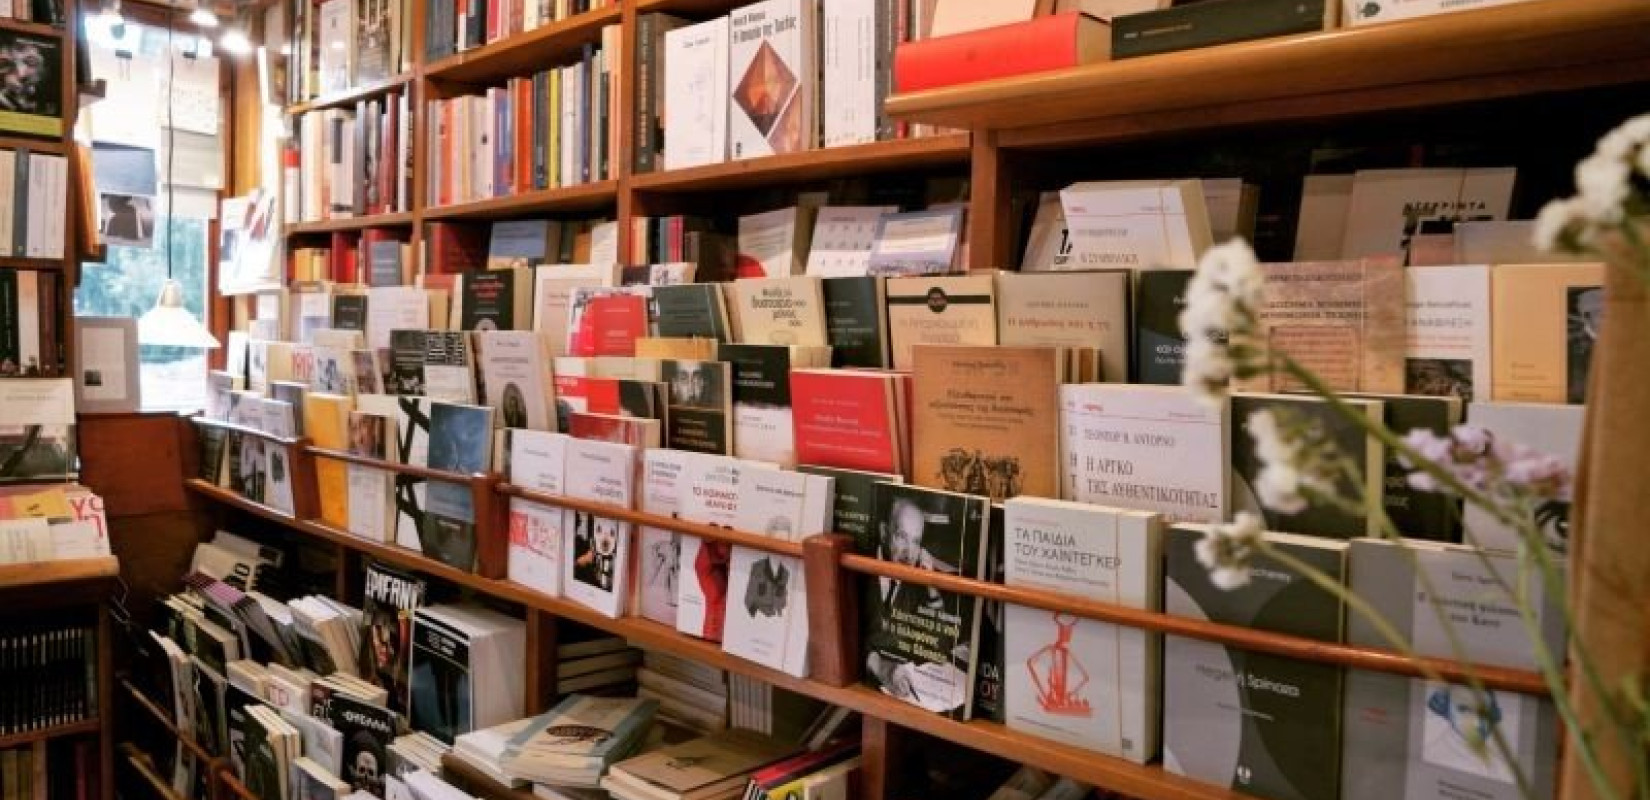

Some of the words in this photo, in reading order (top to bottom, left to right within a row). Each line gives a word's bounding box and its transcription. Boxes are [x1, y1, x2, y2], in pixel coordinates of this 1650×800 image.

[1086, 455, 1094, 472] Η
[1098, 459, 1134, 475] ΑΡΓΚΟ
[1111, 481, 1219, 508] ΑΥΘΕΝΤΙΚΟΤΗΤΑΣ
[1014, 527, 1030, 542] ΤΑ
[1033, 529, 1076, 546] ΠΑΙΔΙΑ
[1014, 542, 1039, 556] ΤΟΥ
[1041, 547, 1122, 569] ΧΑΙΝΤΕΓΚΕΡ
[1247, 673, 1300, 697] Spinoza
